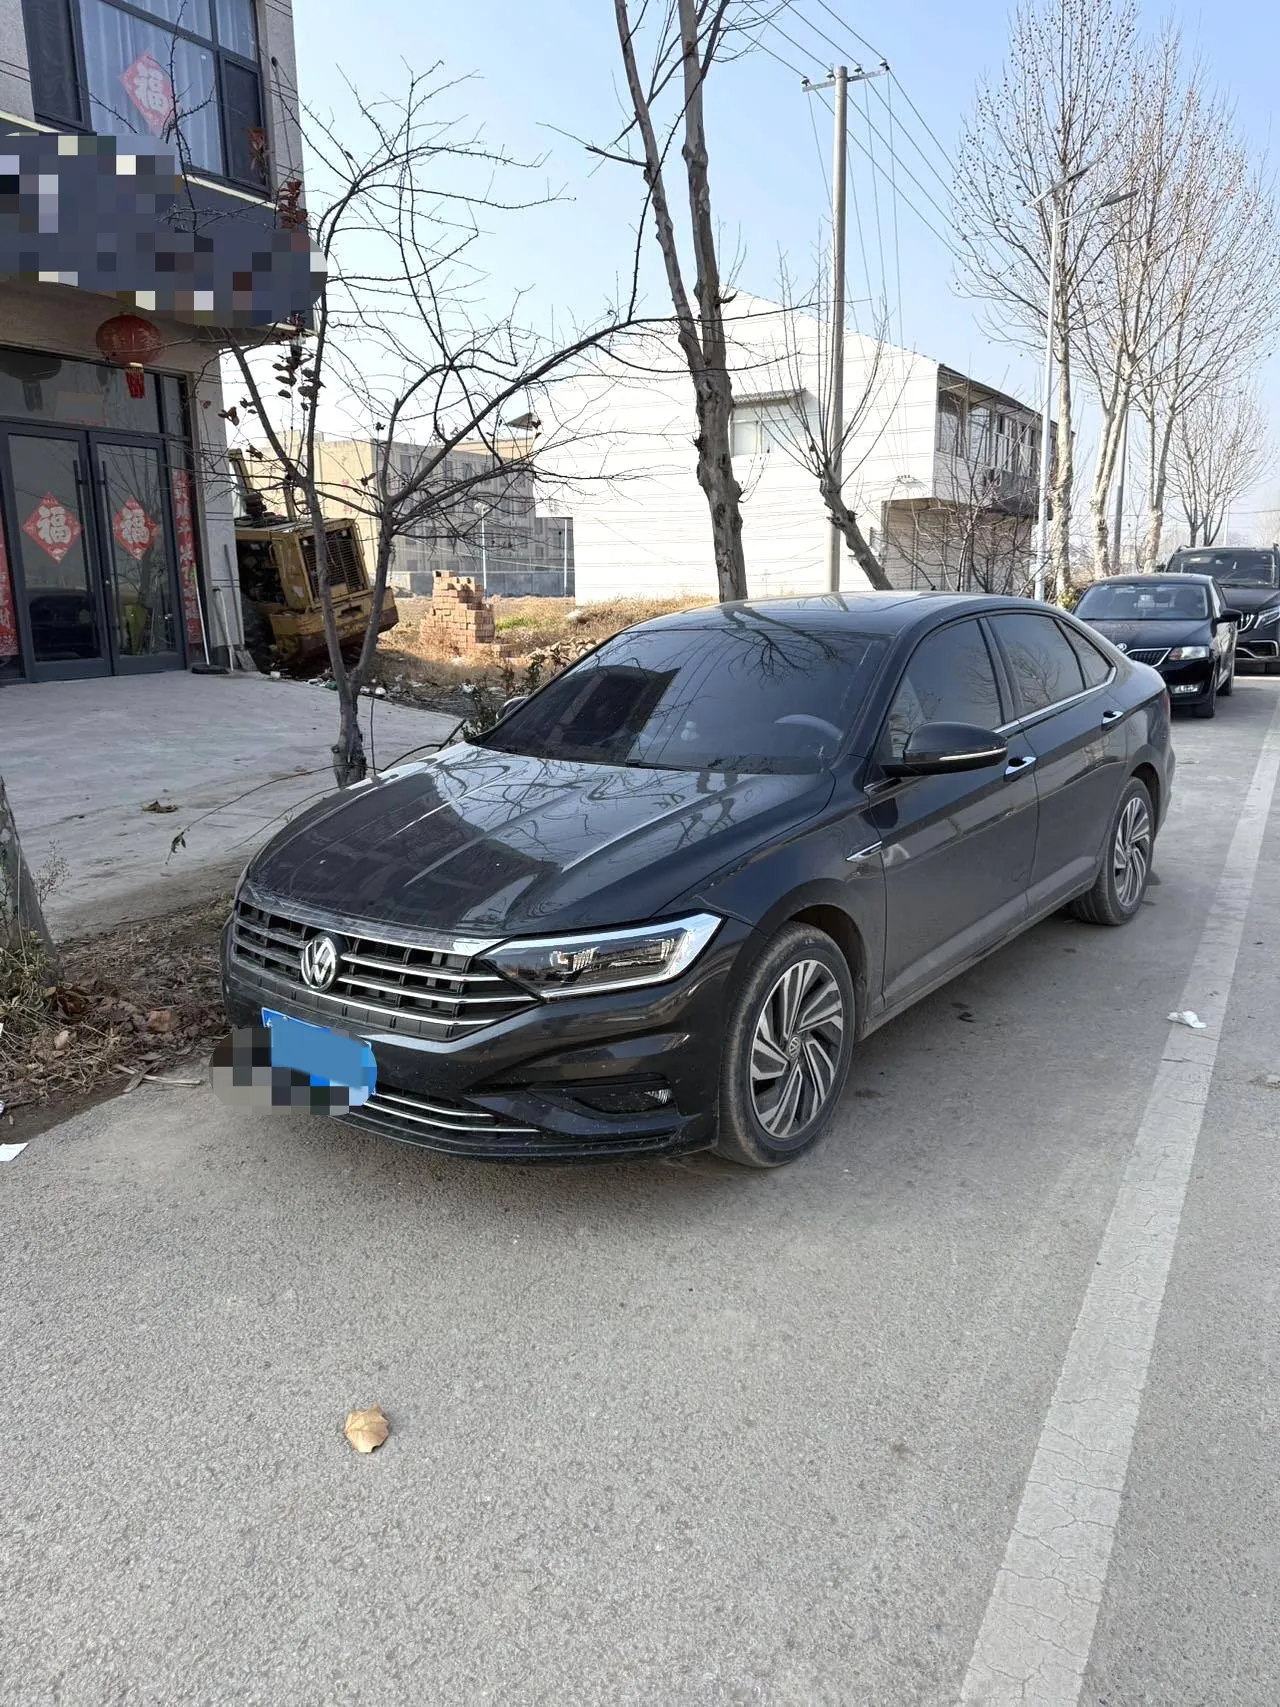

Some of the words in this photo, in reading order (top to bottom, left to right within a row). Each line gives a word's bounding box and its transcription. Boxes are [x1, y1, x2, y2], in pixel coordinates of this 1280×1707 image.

[134, 61, 170, 115] 福
[37, 506, 71, 545] 福
[120, 507, 149, 545] 福
